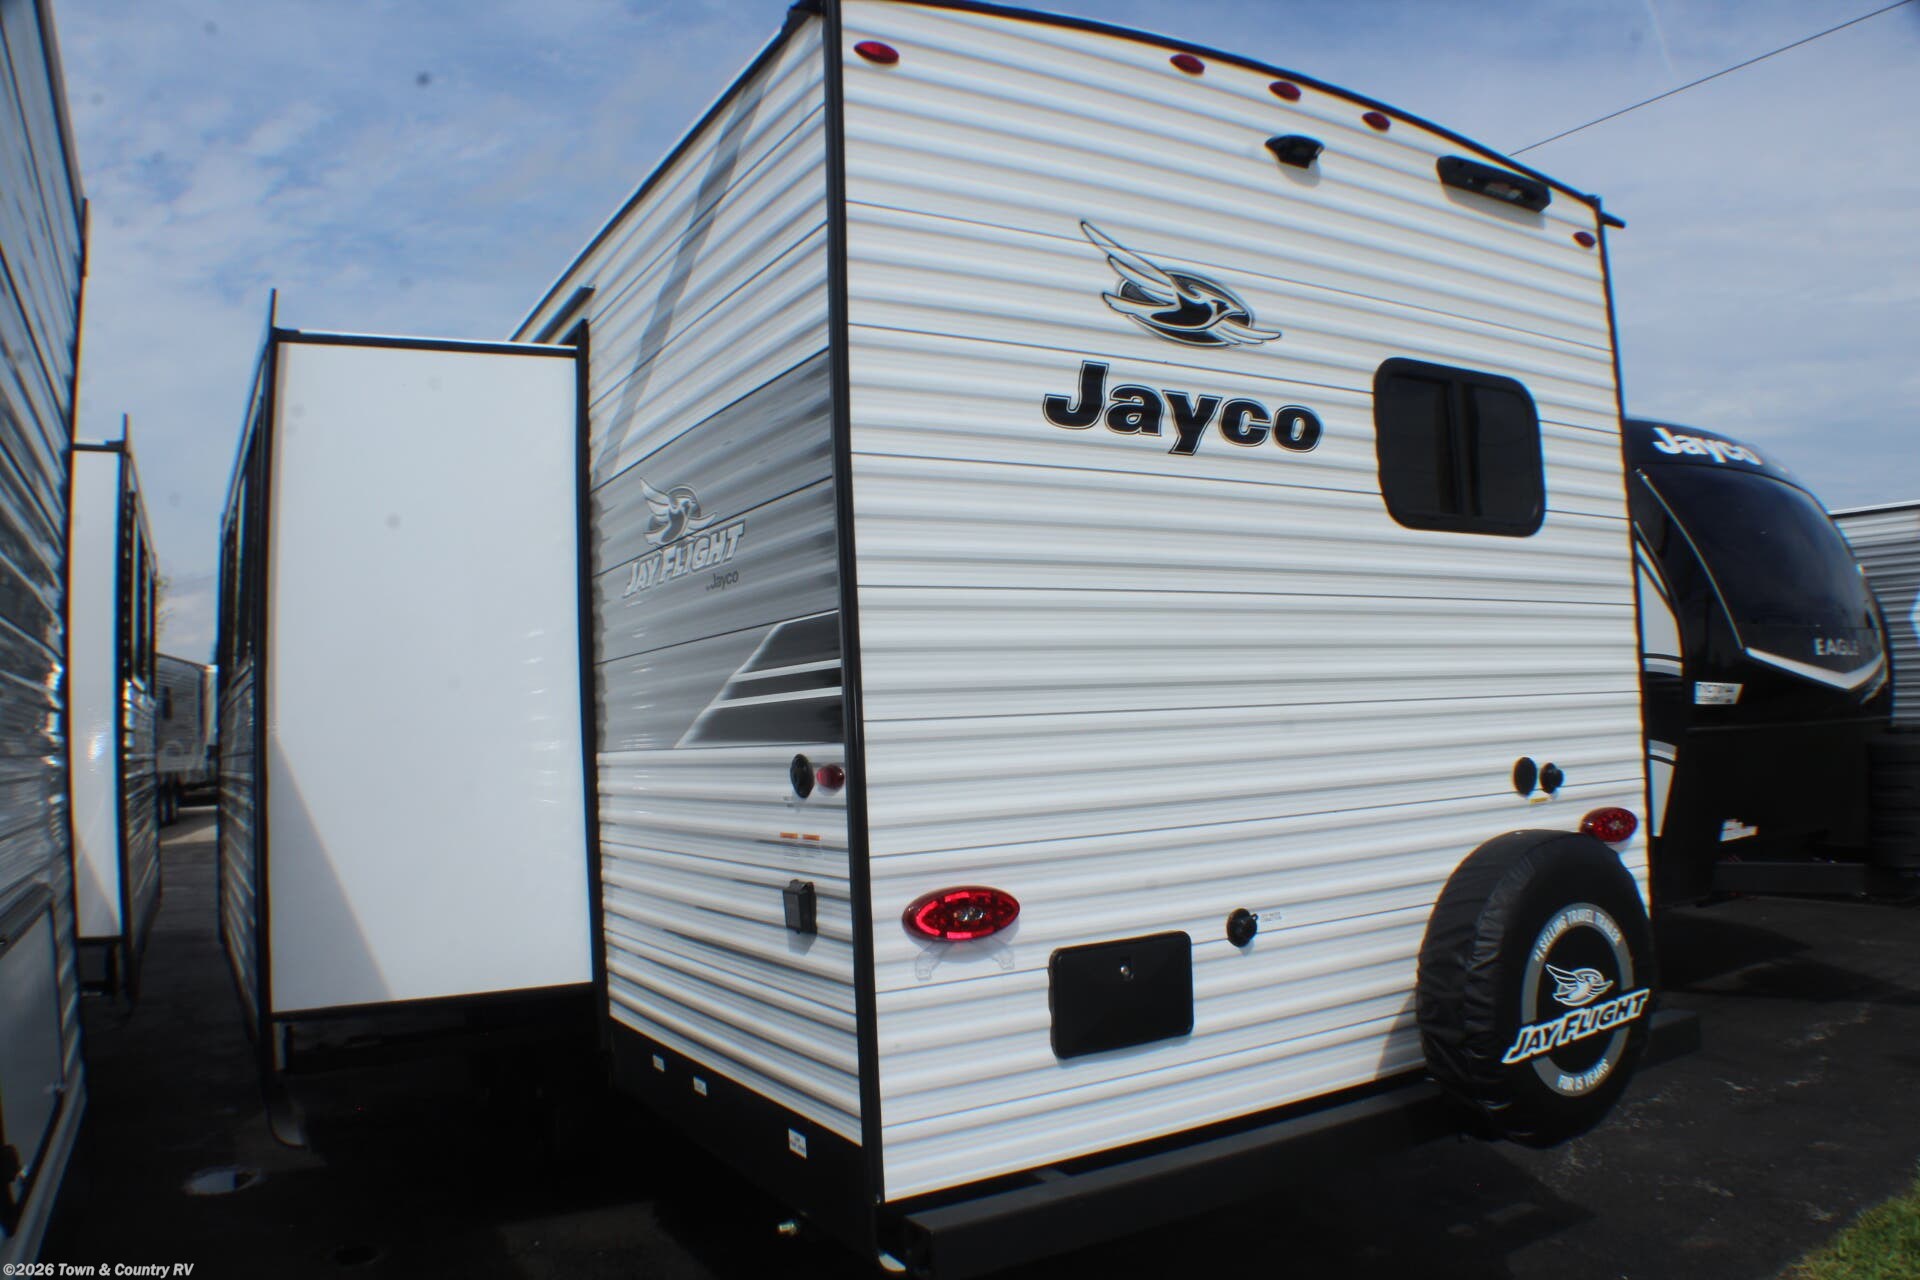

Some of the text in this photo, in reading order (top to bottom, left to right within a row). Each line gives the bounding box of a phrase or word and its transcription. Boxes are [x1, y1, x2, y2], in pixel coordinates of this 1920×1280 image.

[1042, 360, 1324, 456] Jayco
[1652, 427, 1763, 465] Jayco
[656, 520, 745, 585] FLIGHT
[710, 570, 739, 591] Jayco
[1814, 637, 1859, 656] EAGLE
[1540, 914, 1568, 953] SELLING
[1583, 1057, 1609, 1088] YEARS
